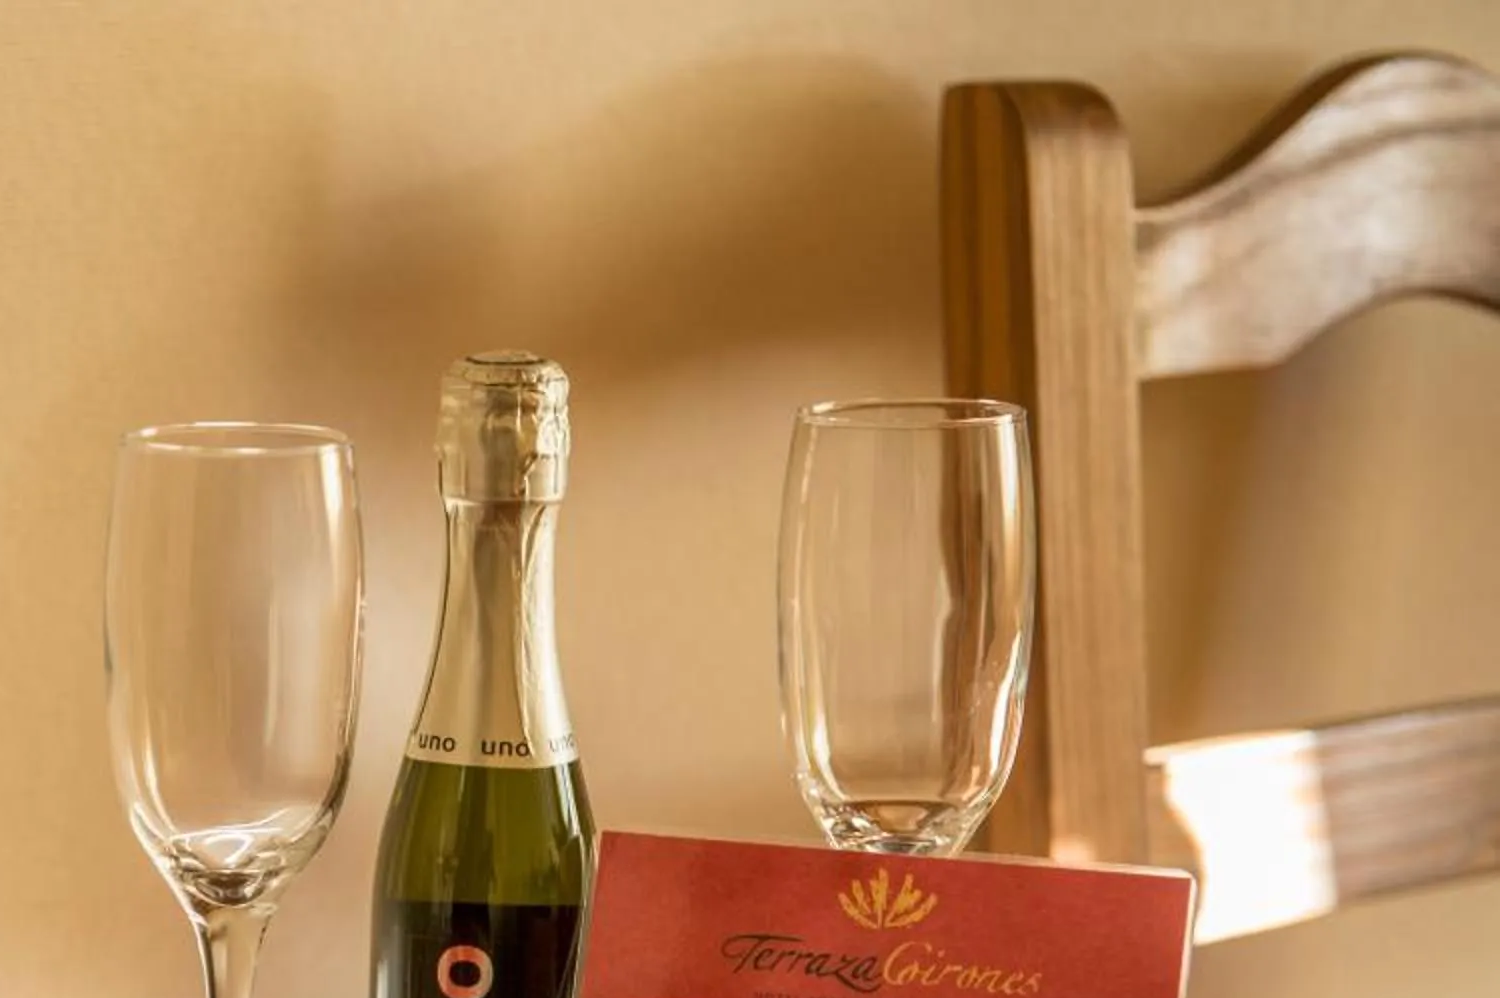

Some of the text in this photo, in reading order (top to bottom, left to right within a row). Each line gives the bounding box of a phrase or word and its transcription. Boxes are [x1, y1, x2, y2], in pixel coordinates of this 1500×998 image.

[419, 734, 456, 752] uno
[481, 740, 531, 757] uno
[721, 934, 1043, 995] Terraza Coirones
